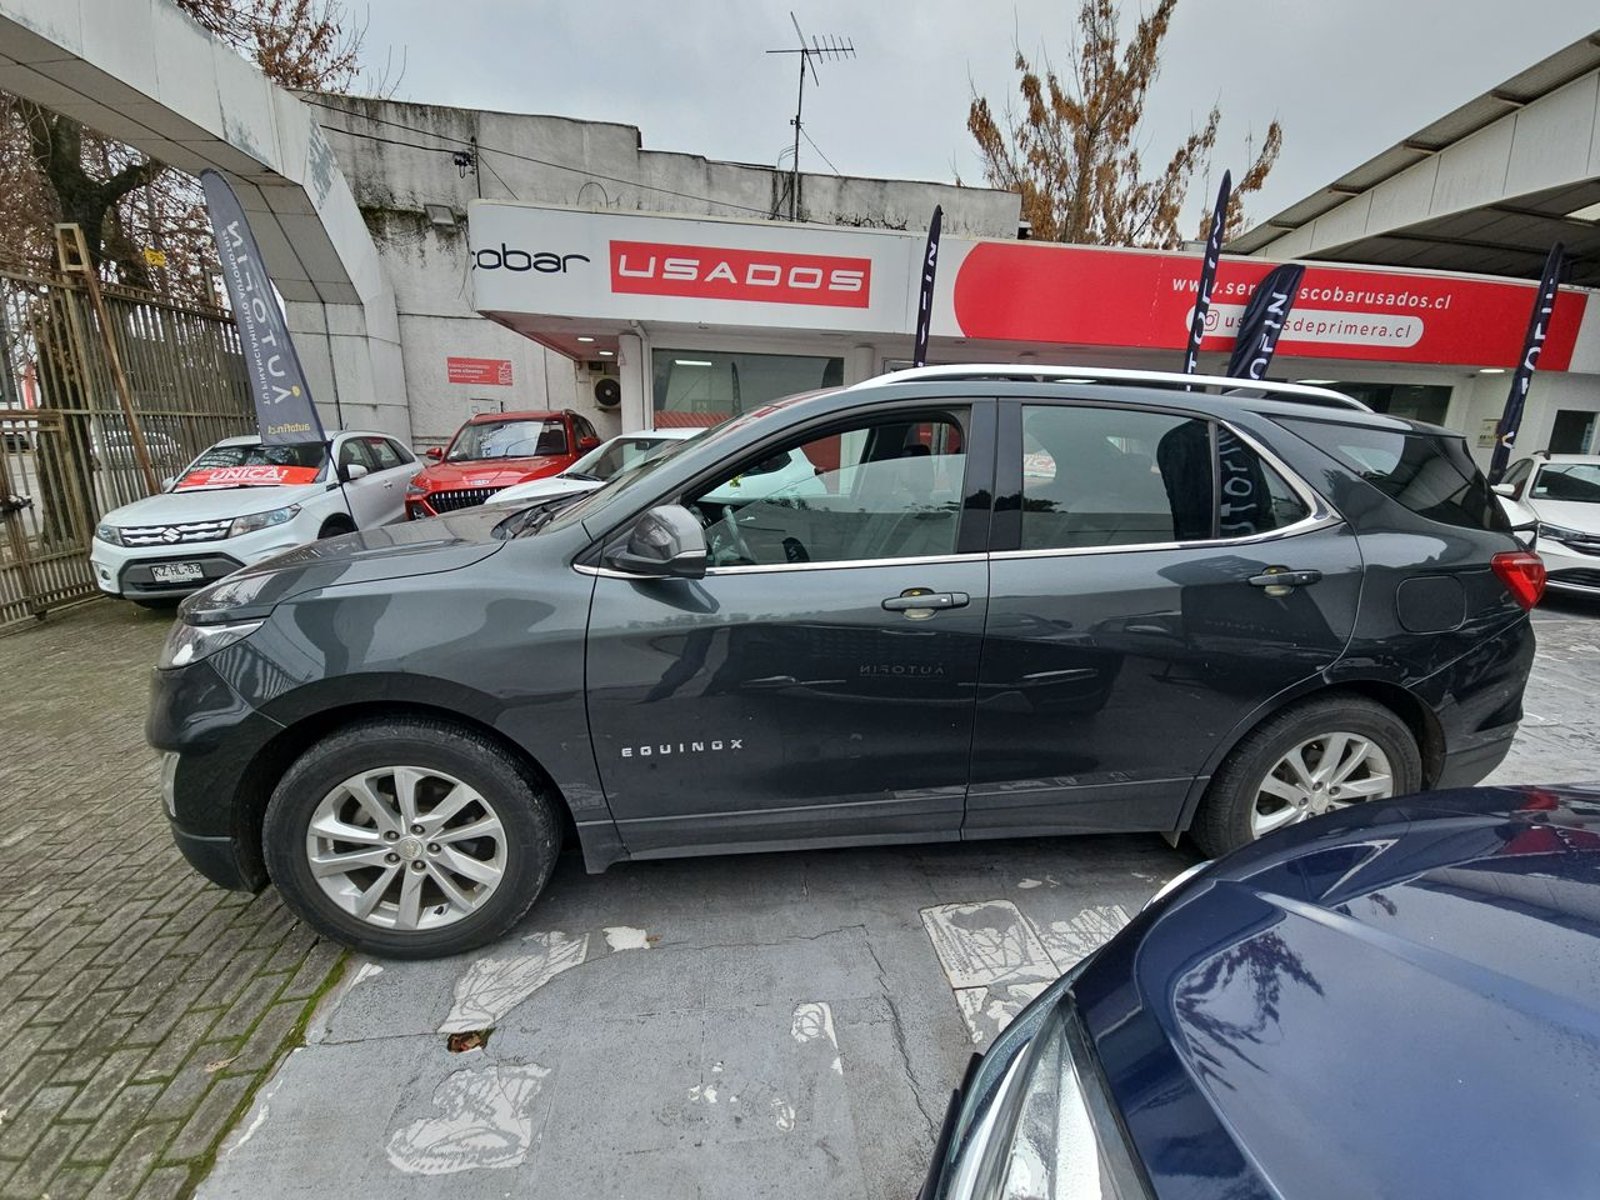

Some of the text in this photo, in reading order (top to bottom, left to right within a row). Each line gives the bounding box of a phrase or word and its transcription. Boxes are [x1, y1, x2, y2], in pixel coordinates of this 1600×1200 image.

[471, 243, 590, 273] obar
[618, 254, 864, 292] USADOS
[621, 740, 743, 757] EQUINOX
